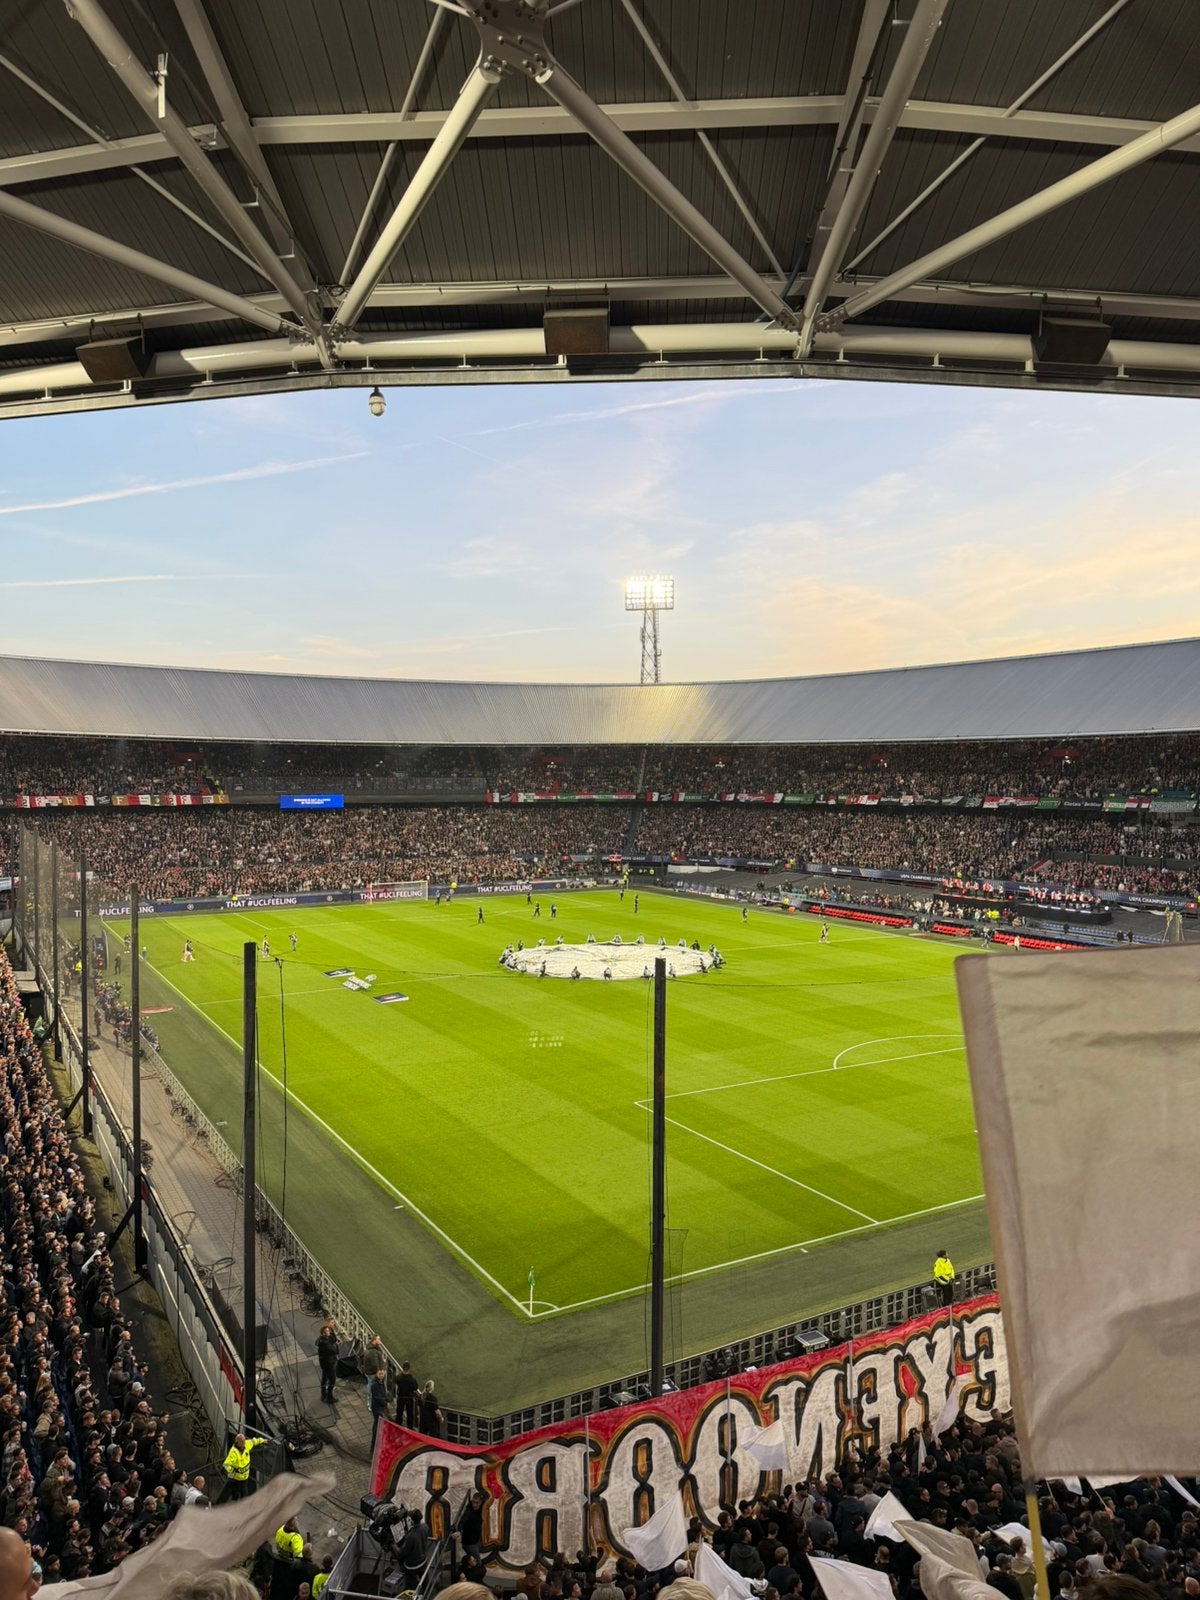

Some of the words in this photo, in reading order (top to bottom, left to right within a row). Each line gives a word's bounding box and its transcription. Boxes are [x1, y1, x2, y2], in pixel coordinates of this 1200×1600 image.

[378, 889, 423, 899] #UCLFEELING
[226, 900, 246, 908] THAT
[247, 897, 297, 907] #UCLFEELING
[99, 905, 154, 916] #UCLFEING
